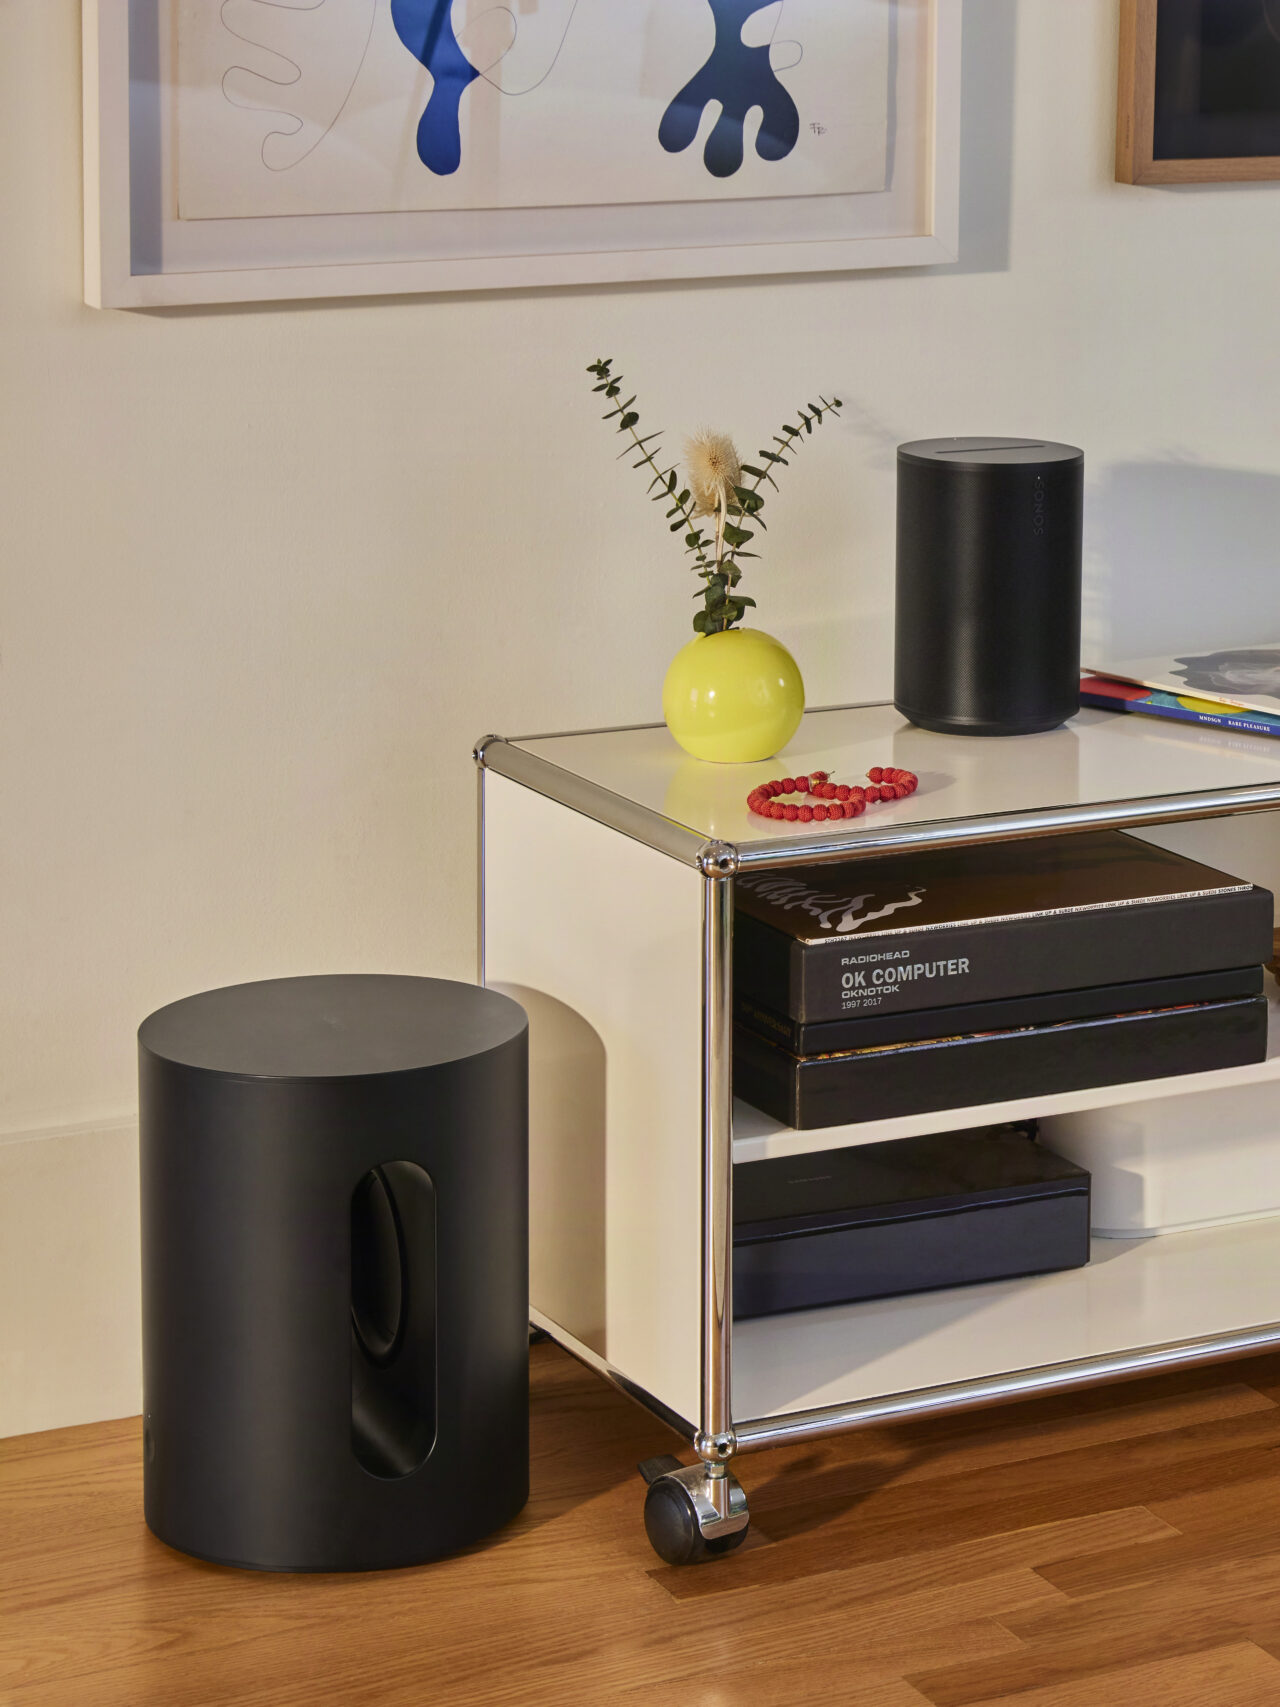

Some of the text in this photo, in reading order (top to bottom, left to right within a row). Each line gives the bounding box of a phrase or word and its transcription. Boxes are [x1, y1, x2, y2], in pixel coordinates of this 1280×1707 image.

[1032, 479, 1045, 536] SONOS
[1199, 715, 1222, 723] MNDSGN
[1243, 722, 1271, 732] PLEASURE
[841, 950, 910, 966] RADIOHEAD
[841, 957, 970, 989] OK COMPUTER
[841, 984, 900, 999] OKNOTOK
[841, 997, 882, 1010] 1997 2017
